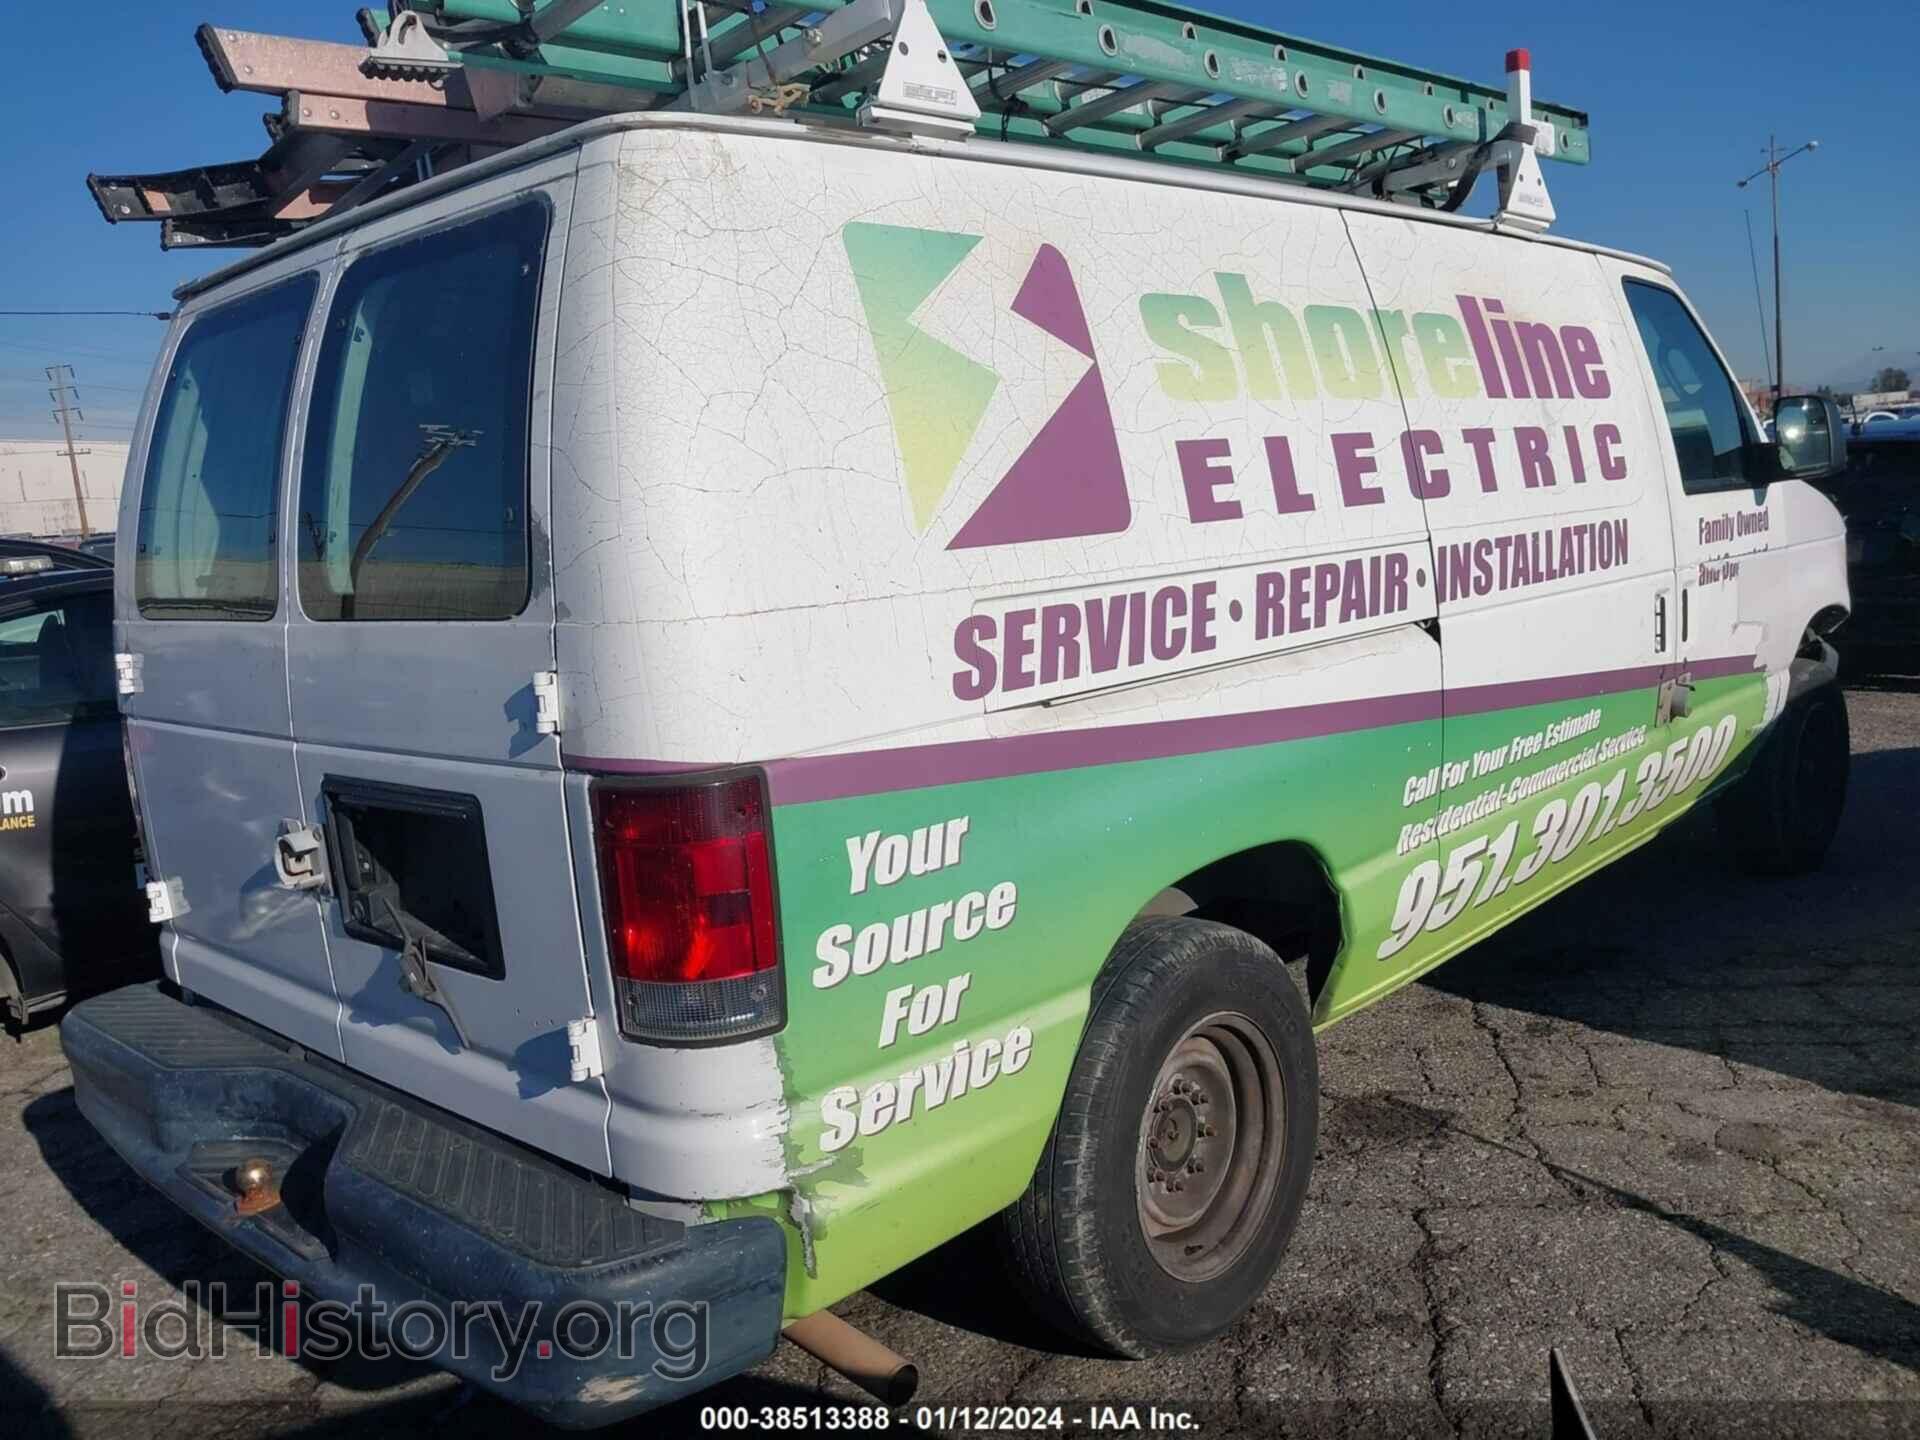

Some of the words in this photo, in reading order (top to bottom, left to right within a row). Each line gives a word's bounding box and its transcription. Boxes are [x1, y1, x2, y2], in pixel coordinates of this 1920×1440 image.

[1138, 272, 1611, 401] shoreline
[1175, 424, 1628, 524] ELECTRIC
[1698, 513, 1735, 545] Family
[1736, 506, 1769, 537] Owned
[952, 580, 1217, 701] SERVICE
[1255, 552, 1408, 641] REPAIR
[1437, 518, 1629, 604] INSTALLATION
[1403, 767, 1440, 808] Call
[1442, 758, 1470, 791] For
[1471, 745, 1509, 778] Your
[1509, 731, 1543, 762] Free
[1543, 708, 1602, 750] Estimate
[1599, 724, 1647, 761] Service
[846, 815, 970, 895] Your
[1377, 714, 1736, 960] 951.301.3500
[812, 880, 1018, 989] Source
[878, 972, 972, 1049] For
[819, 1025, 1034, 1153] Service
